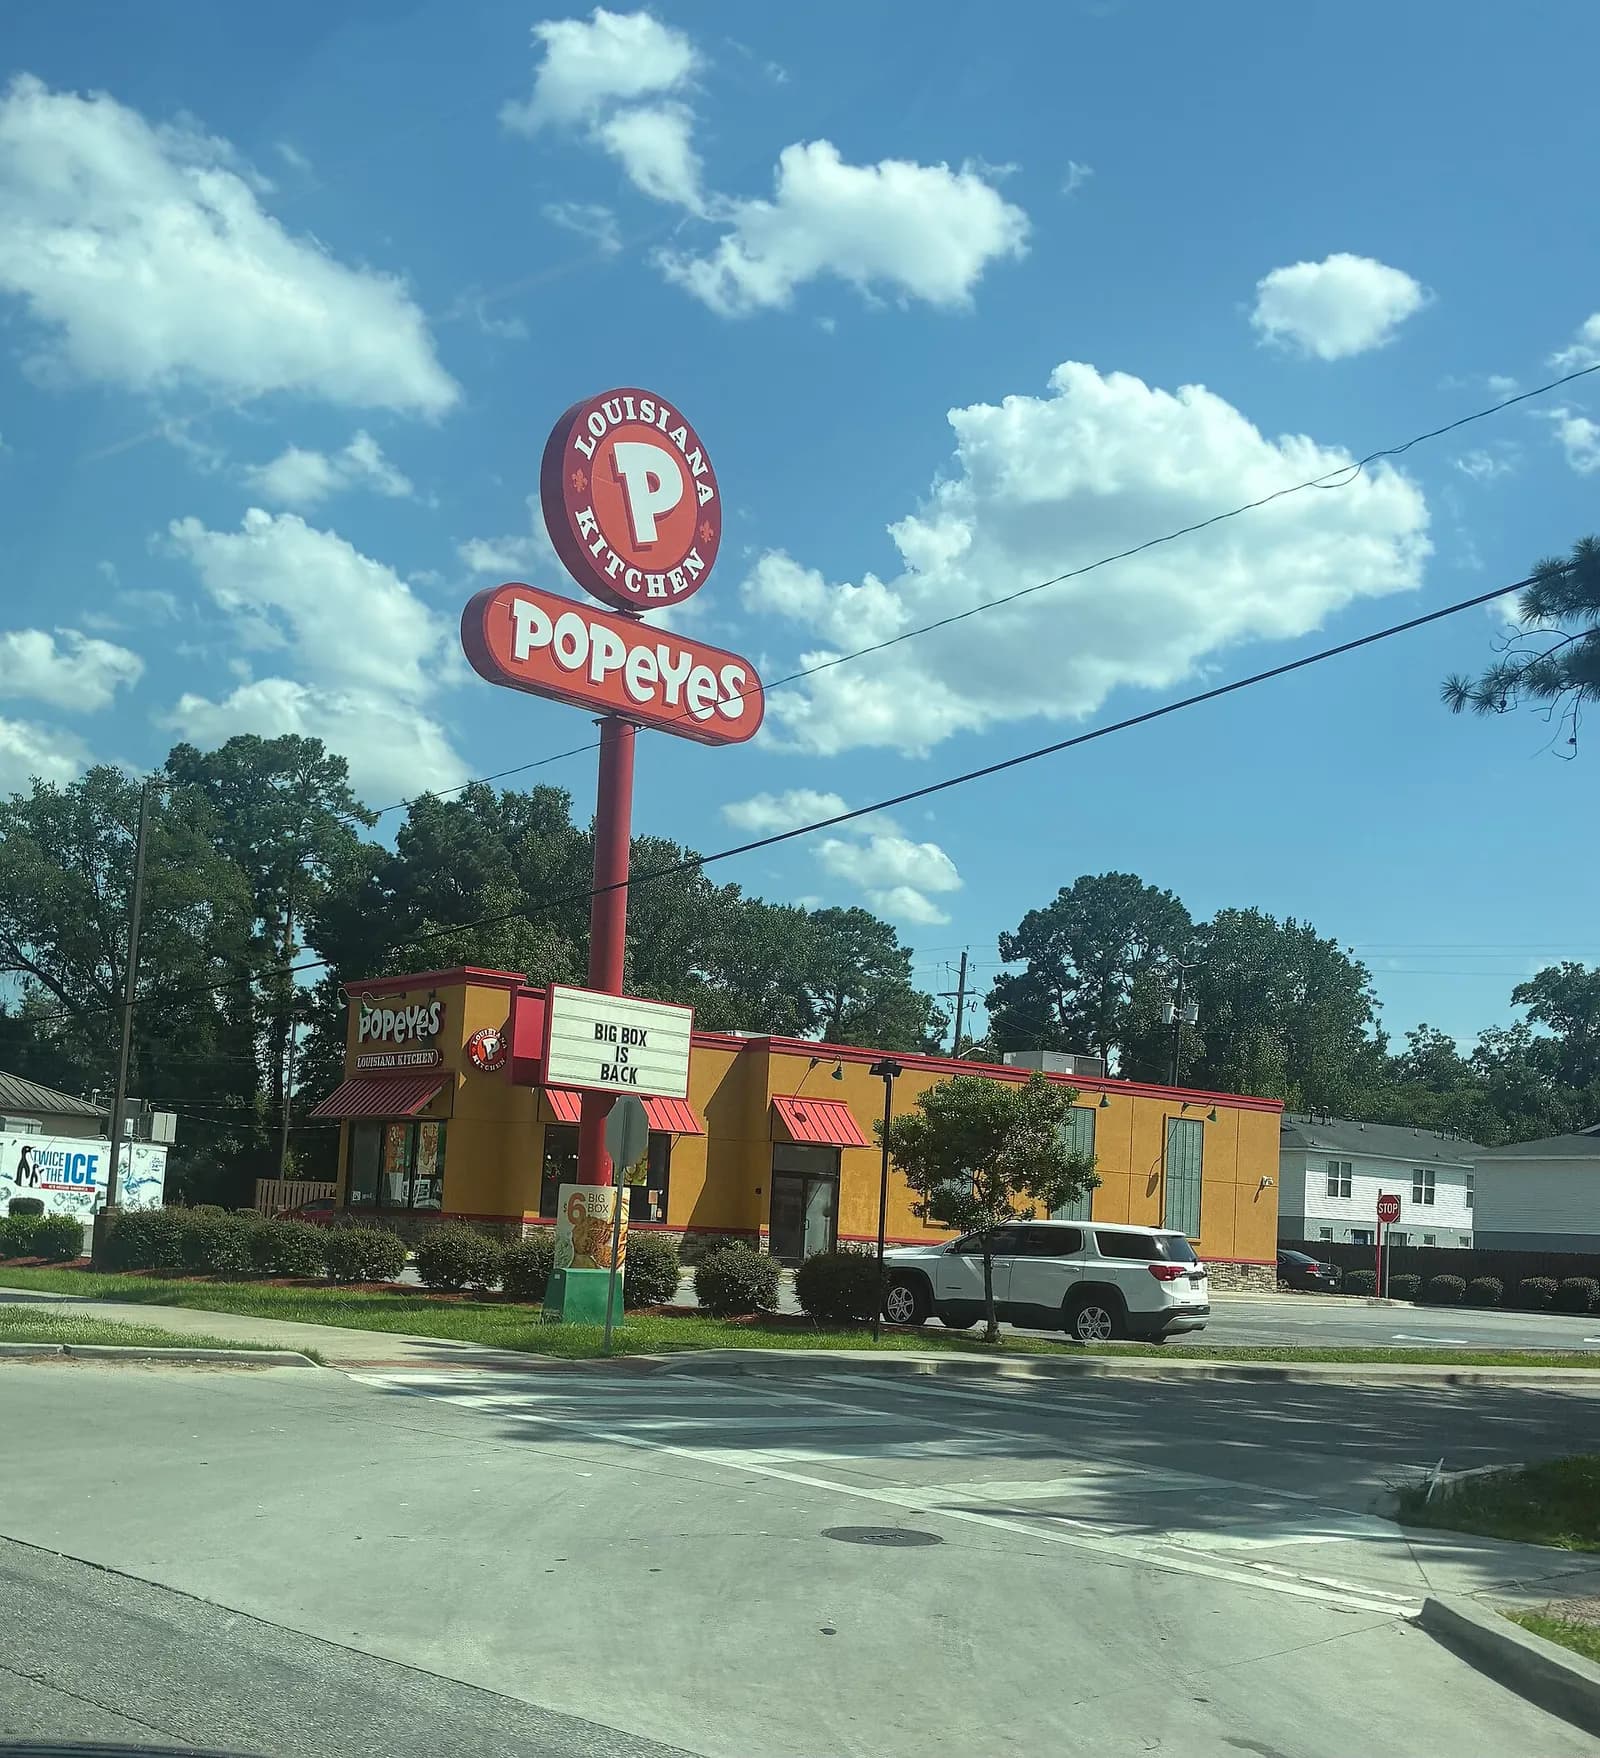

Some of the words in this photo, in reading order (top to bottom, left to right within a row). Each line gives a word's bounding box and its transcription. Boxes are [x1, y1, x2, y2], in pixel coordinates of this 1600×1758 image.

[574, 397, 714, 506] LOUISIANA
[613, 441, 684, 543] P
[575, 506, 706, 597] KITCHEN
[595, 1023, 617, 1043] BIG
[621, 1027, 647, 1047] BOX
[357, 1056, 396, 1068] LOUISIANA
[398, 1052, 434, 1065] KITCHEN
[616, 1046, 628, 1063] IS
[601, 1064, 638, 1084] BACK
[33, 1150, 64, 1167] TWICE
[46, 1168, 63, 1182] THE
[64, 1153, 98, 1185] ICE
[588, 1193, 605, 1202] BIG
[587, 1204, 609, 1213] BOX
[1378, 1203, 1398, 1214] STOP
